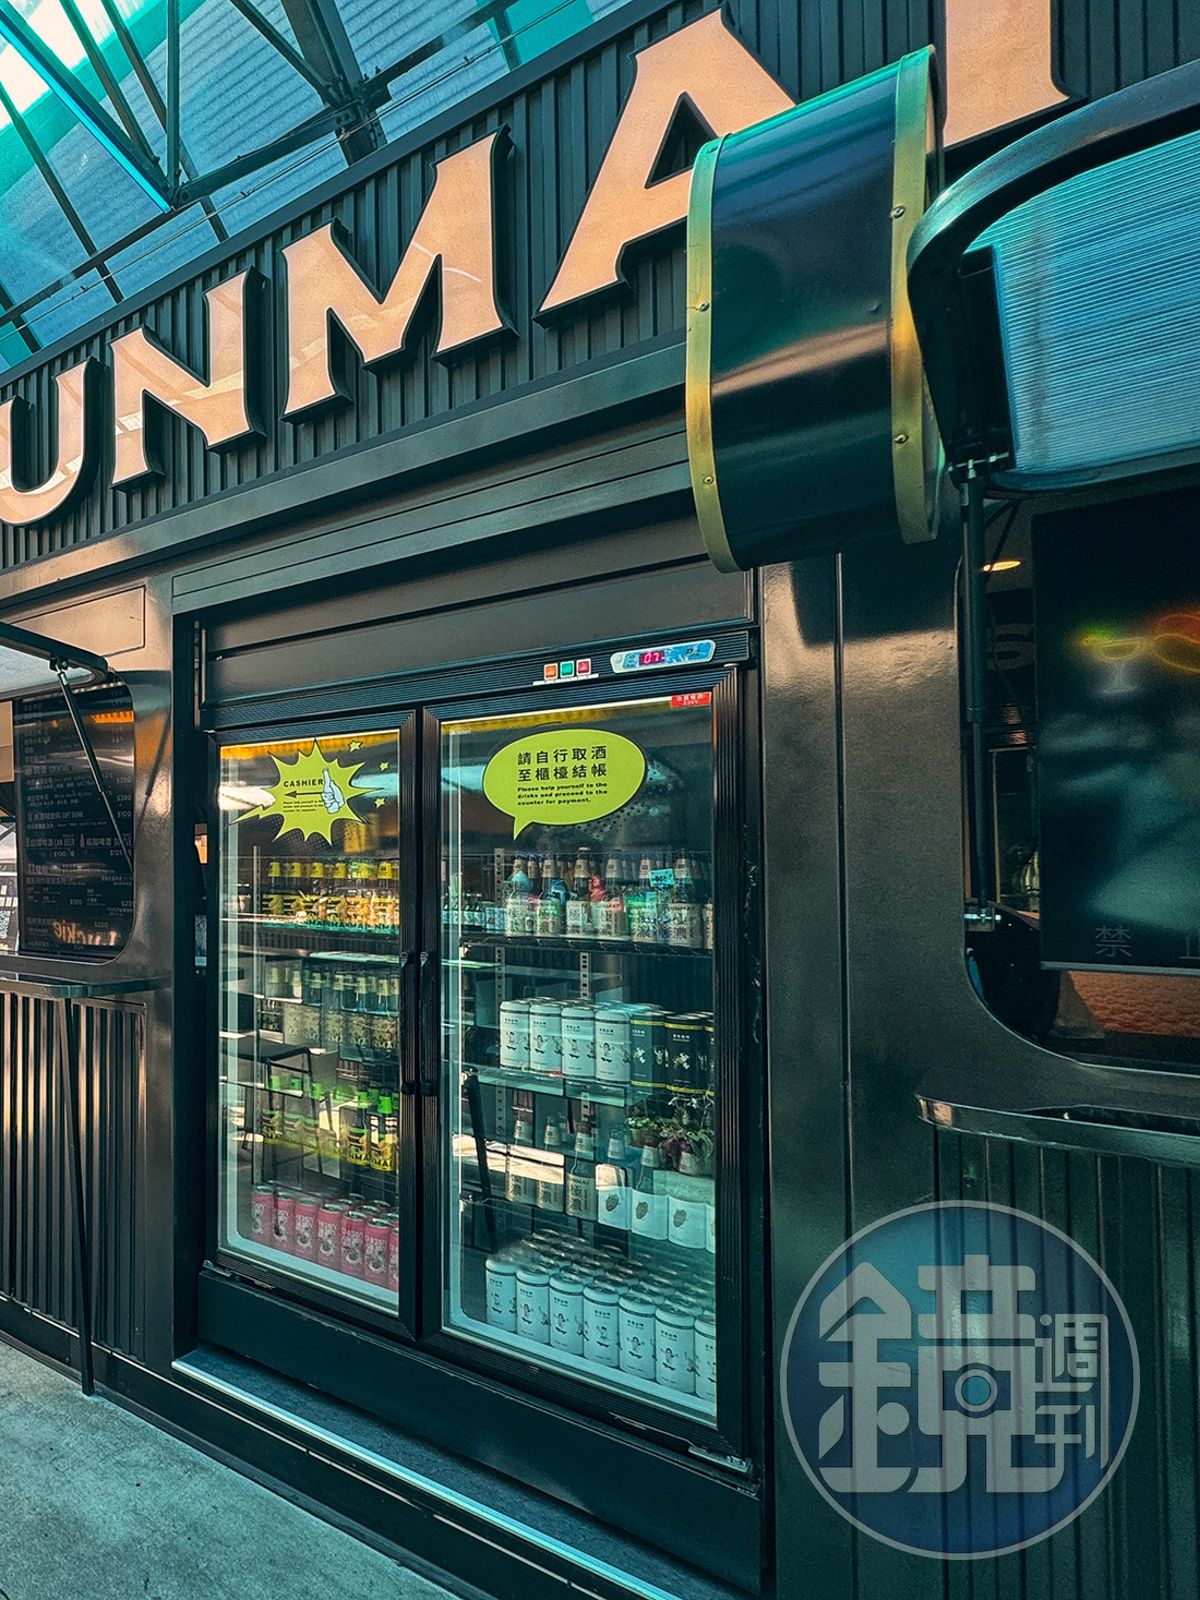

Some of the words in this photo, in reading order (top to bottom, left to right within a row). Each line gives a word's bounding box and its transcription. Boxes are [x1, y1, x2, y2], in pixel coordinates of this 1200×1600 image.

[517, 745, 607, 766] 請自行取酒
[517, 763, 607, 782] 至櫃檯結帳
[283, 779, 323, 788] CASHIER
[556, 783, 585, 791] yourself
